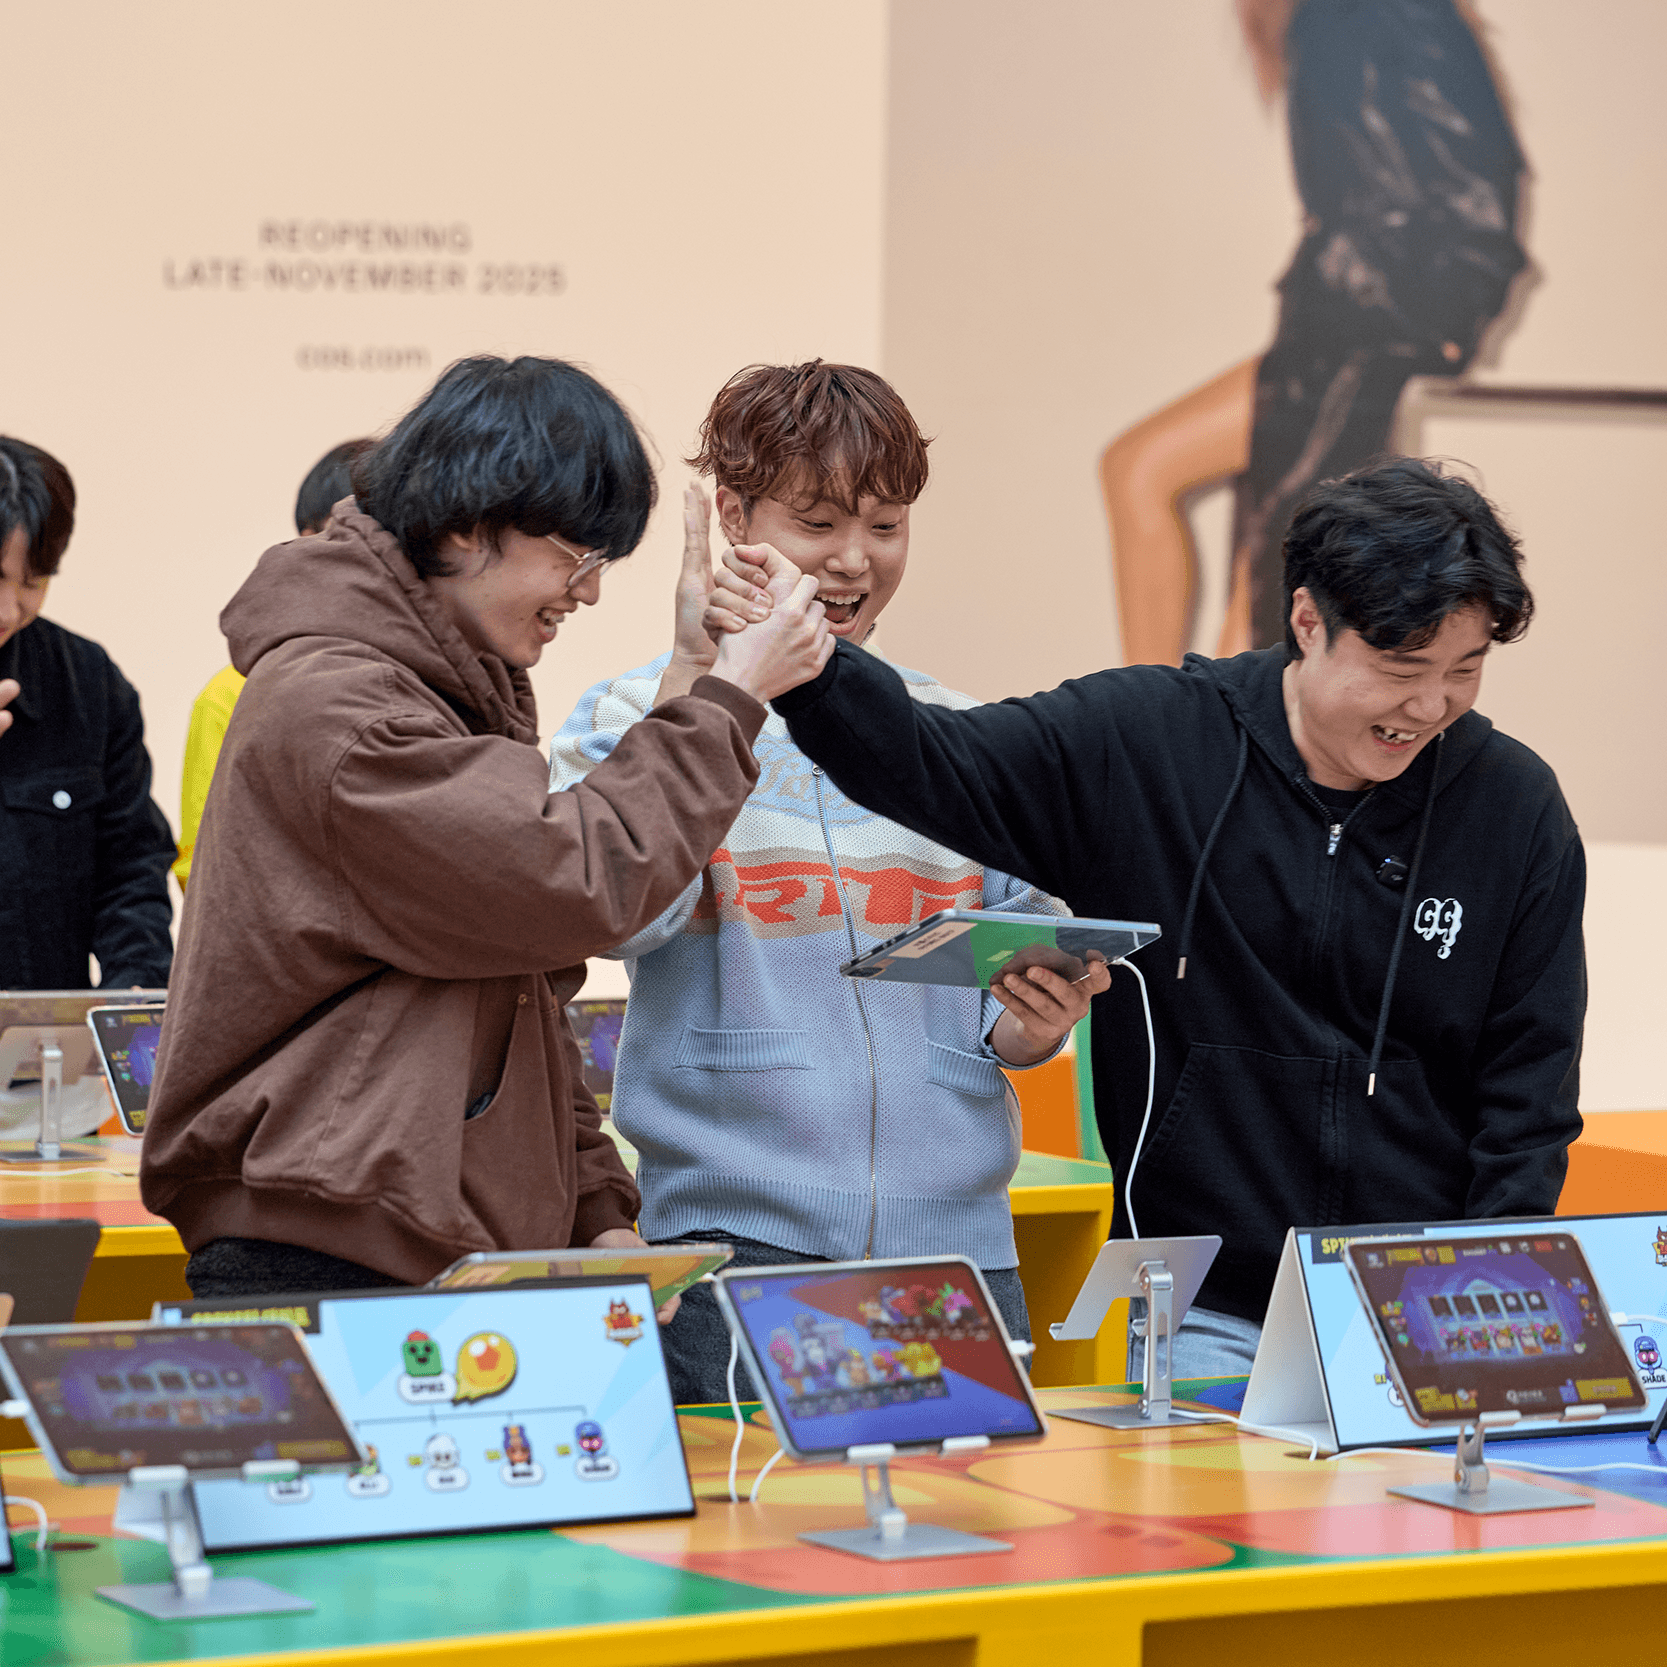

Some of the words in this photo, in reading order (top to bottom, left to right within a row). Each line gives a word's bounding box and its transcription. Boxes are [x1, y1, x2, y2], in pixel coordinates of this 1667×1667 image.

[259, 219, 472, 254] REOPENING
[478, 260, 567, 296] 2025
[297, 345, 431, 372] cos.com
[1641, 1373, 1667, 1384] SHADE
